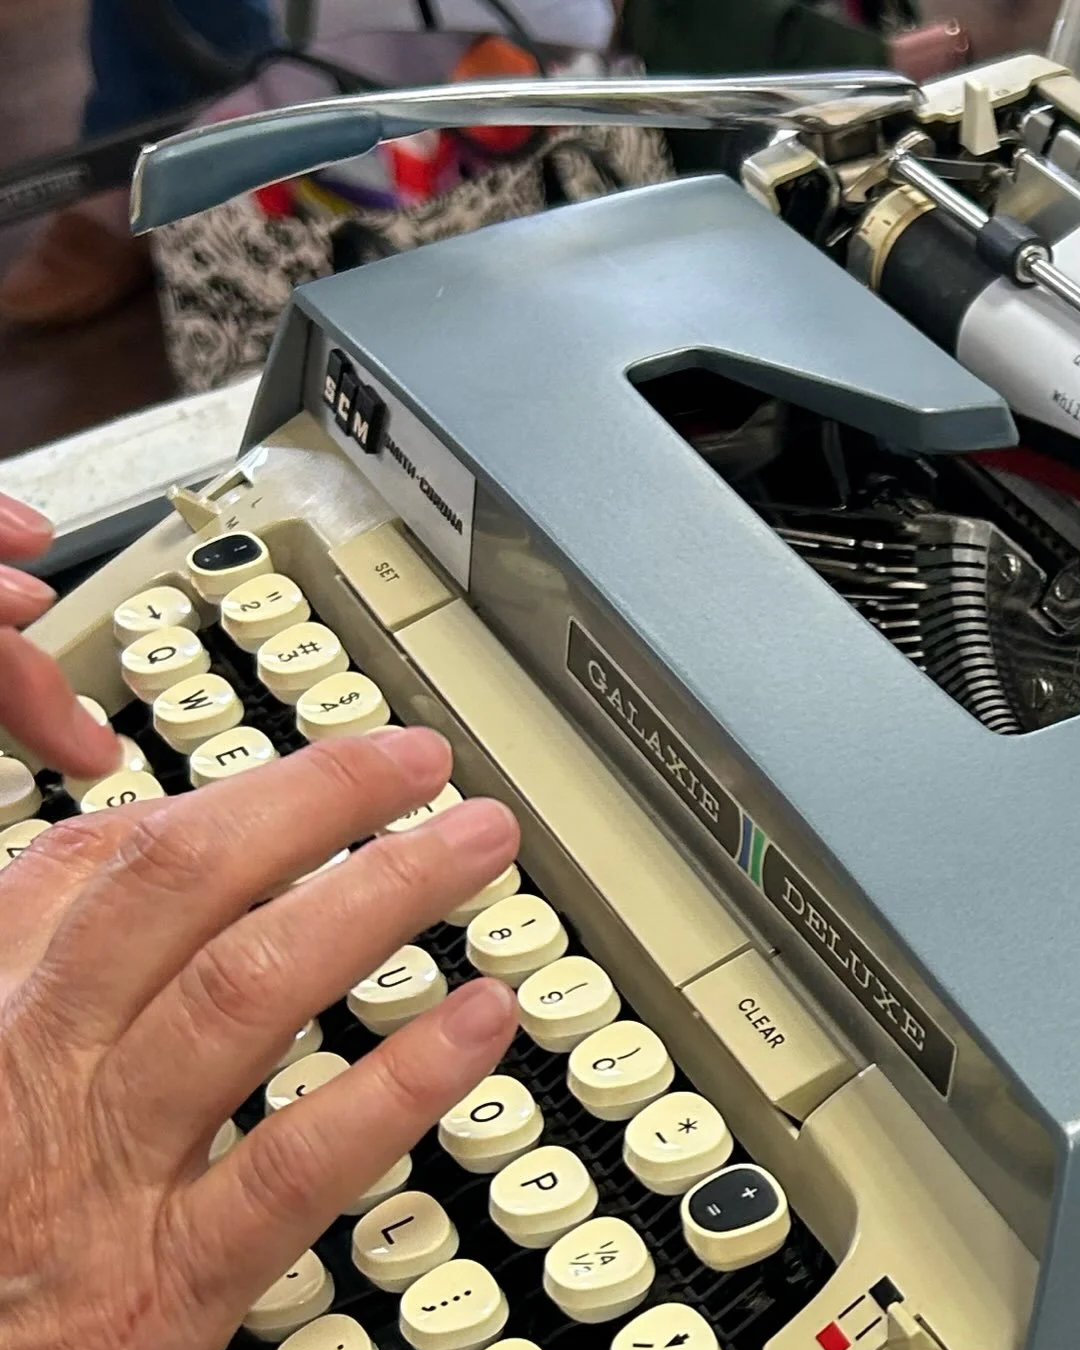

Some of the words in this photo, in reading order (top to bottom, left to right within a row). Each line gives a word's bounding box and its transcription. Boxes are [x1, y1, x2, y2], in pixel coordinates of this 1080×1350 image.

[375, 562, 400, 583] SET
[147, 645, 178, 664] Q
[178, 688, 215, 714] W
[587, 658, 721, 824] GALAXIE
[215, 744, 250, 767] E
[781, 875, 928, 1052] DELUXE
[376, 964, 415, 989] U
[737, 997, 786, 1050] CLEAR
[520, 1171, 558, 1192] P
[381, 1215, 415, 1246] L
